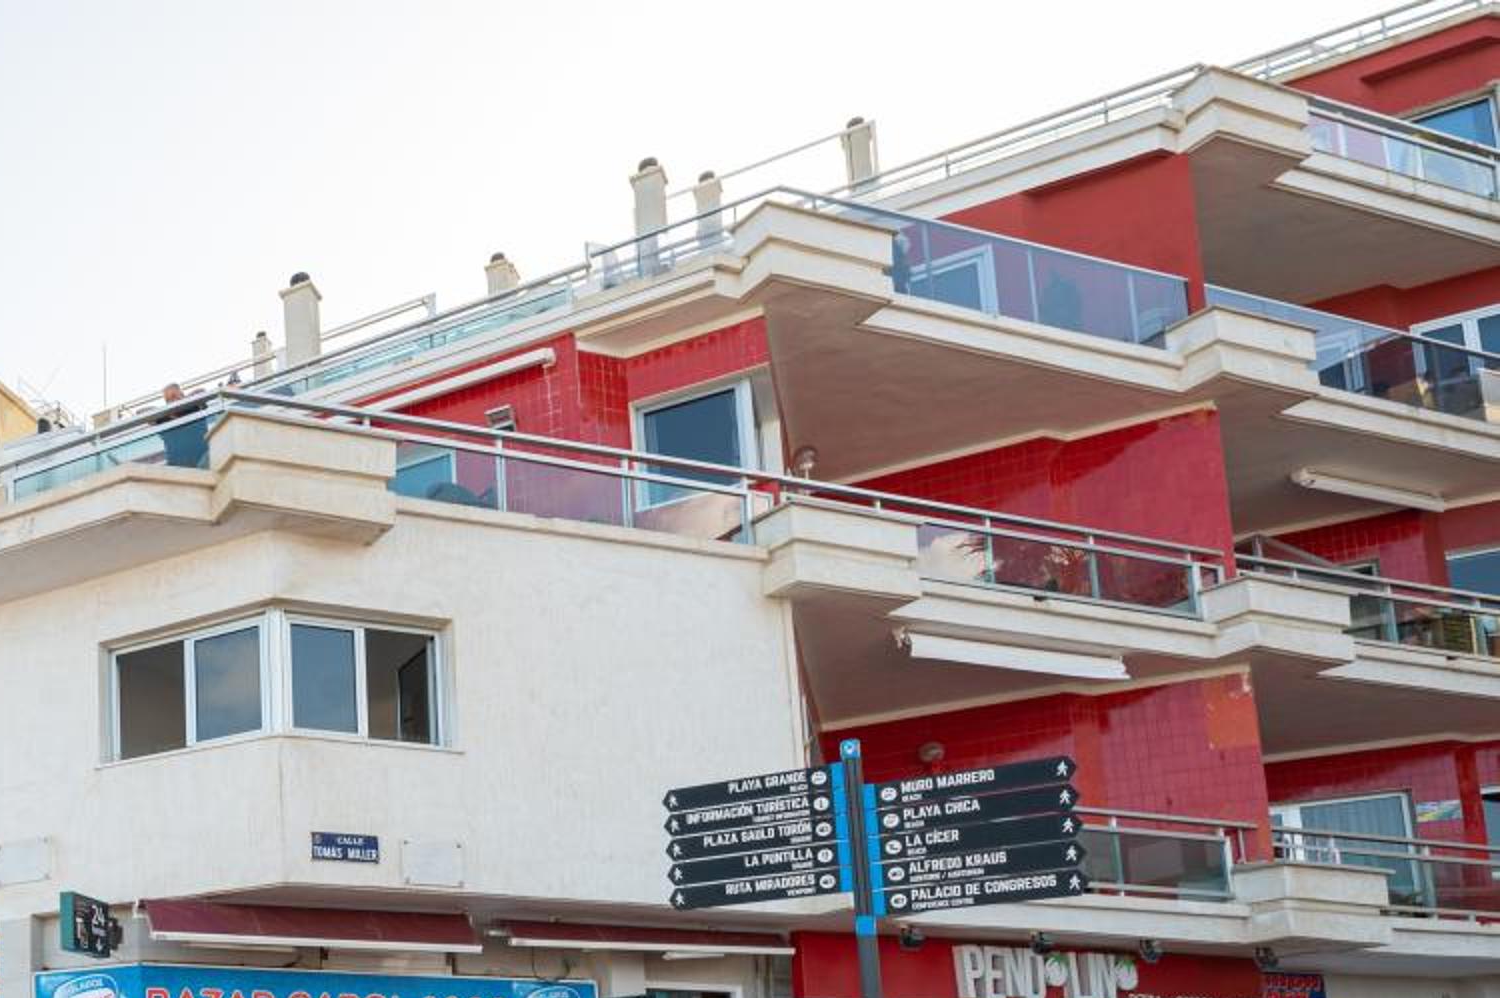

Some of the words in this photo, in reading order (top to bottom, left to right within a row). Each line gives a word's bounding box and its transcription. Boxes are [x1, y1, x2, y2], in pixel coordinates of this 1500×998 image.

[728, 779, 763, 794] PLAYA
[765, 772, 808, 788] GRANDE
[901, 777, 934, 793] MURO
[936, 769, 996, 788] MARRERO
[685, 805, 754, 825] INFORMACIÓN
[756, 797, 809, 814] TURÍSTICA
[903, 805, 941, 820] PLAYA
[944, 799, 981, 815] CHICA
[703, 832, 739, 847] PLAZA
[777, 821, 813, 837] TORÓN
[905, 834, 923, 848] LA
[925, 828, 960, 844] CÍCER
[744, 854, 760, 868] LA
[762, 848, 814, 864] PUNTILLA
[909, 856, 963, 875] ALFREDO
[965, 851, 1008, 867] KRAUS
[725, 881, 753, 896] RUTA
[755, 874, 816, 892] MIRADORES
[911, 885, 962, 901] PALACIO
[965, 881, 981, 896] DE
[984, 874, 1058, 894] CONGRESOS
[91, 904, 105, 926] 24
